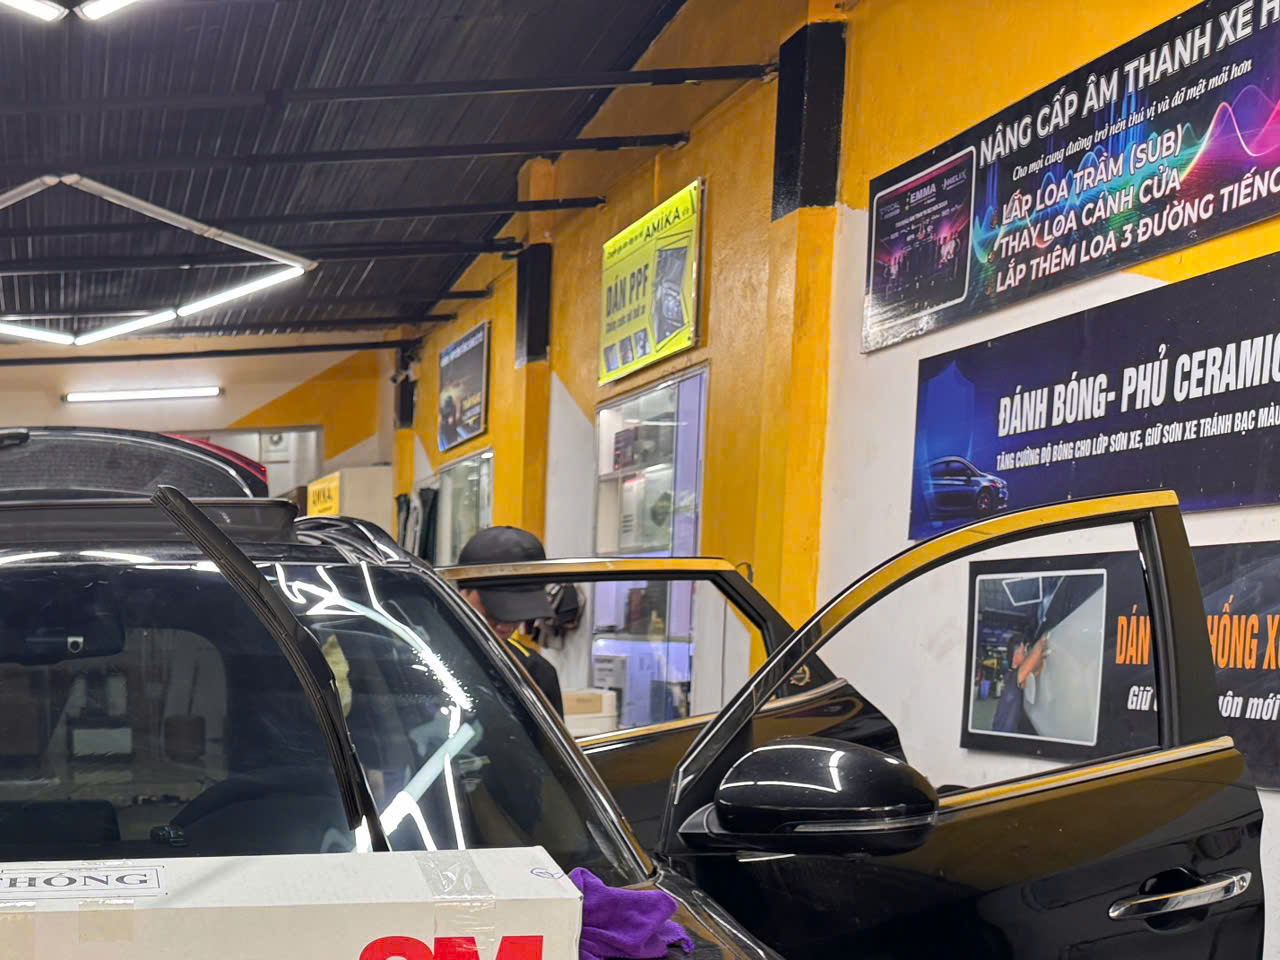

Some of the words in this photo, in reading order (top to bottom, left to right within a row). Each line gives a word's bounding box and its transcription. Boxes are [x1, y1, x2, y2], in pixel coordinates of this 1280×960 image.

[980, 115, 1032, 168] NÂNG
[1036, 86, 1078, 138] CẤP
[1081, 68, 1119, 118] ÂM
[1124, 19, 1213, 95] THANH
[1216, 0, 1254, 51] XE
[1013, 165, 1027, 181] Cho
[1028, 154, 1043, 174] mọi
[1044, 148, 1064, 165] cung
[1066, 135, 1092, 157] đường
[1109, 115, 1126, 136] nên
[1157, 96, 1169, 114] và
[1186, 78, 1207, 100] mệt
[1230, 59, 1253, 81] hơn
[1000, 223, 1041, 258] THAY
[1043, 210, 1077, 242] LOA
[1081, 186, 1134, 226] CÁNH
[1139, 165, 1181, 204] CỬA
[1002, 189, 1032, 225] LẮP
[1036, 178, 1068, 211] LOA
[1073, 152, 1124, 194] TRẦM
[1130, 124, 1182, 174] (SUB)
[629, 263, 648, 305] PPF
[996, 258, 1026, 293] LẮP
[1030, 243, 1076, 280] THÊM
[1080, 231, 1117, 264] LOA
[1120, 224, 1133, 248] 3
[1137, 194, 1214, 243] ĐƯỜNG
[998, 385, 1048, 437] ĐÁNH
[1120, 343, 1168, 413] PHỦ
[996, 451, 1014, 471] TĂNG
[1015, 446, 1040, 468] CƯỜNG
[1041, 442, 1052, 467] ĐỘ
[1052, 440, 1074, 462] BÓNG
[1074, 439, 1091, 458] CHO
[1109, 431, 1128, 452] SƠN
[1162, 421, 1183, 444] SƠN
[1184, 420, 1198, 440] XE
[1200, 412, 1232, 438] TRÁNH
[1234, 409, 1256, 435] BẠC
[1115, 604, 1151, 665] DÁN
[1127, 685, 1153, 711] Giữ
